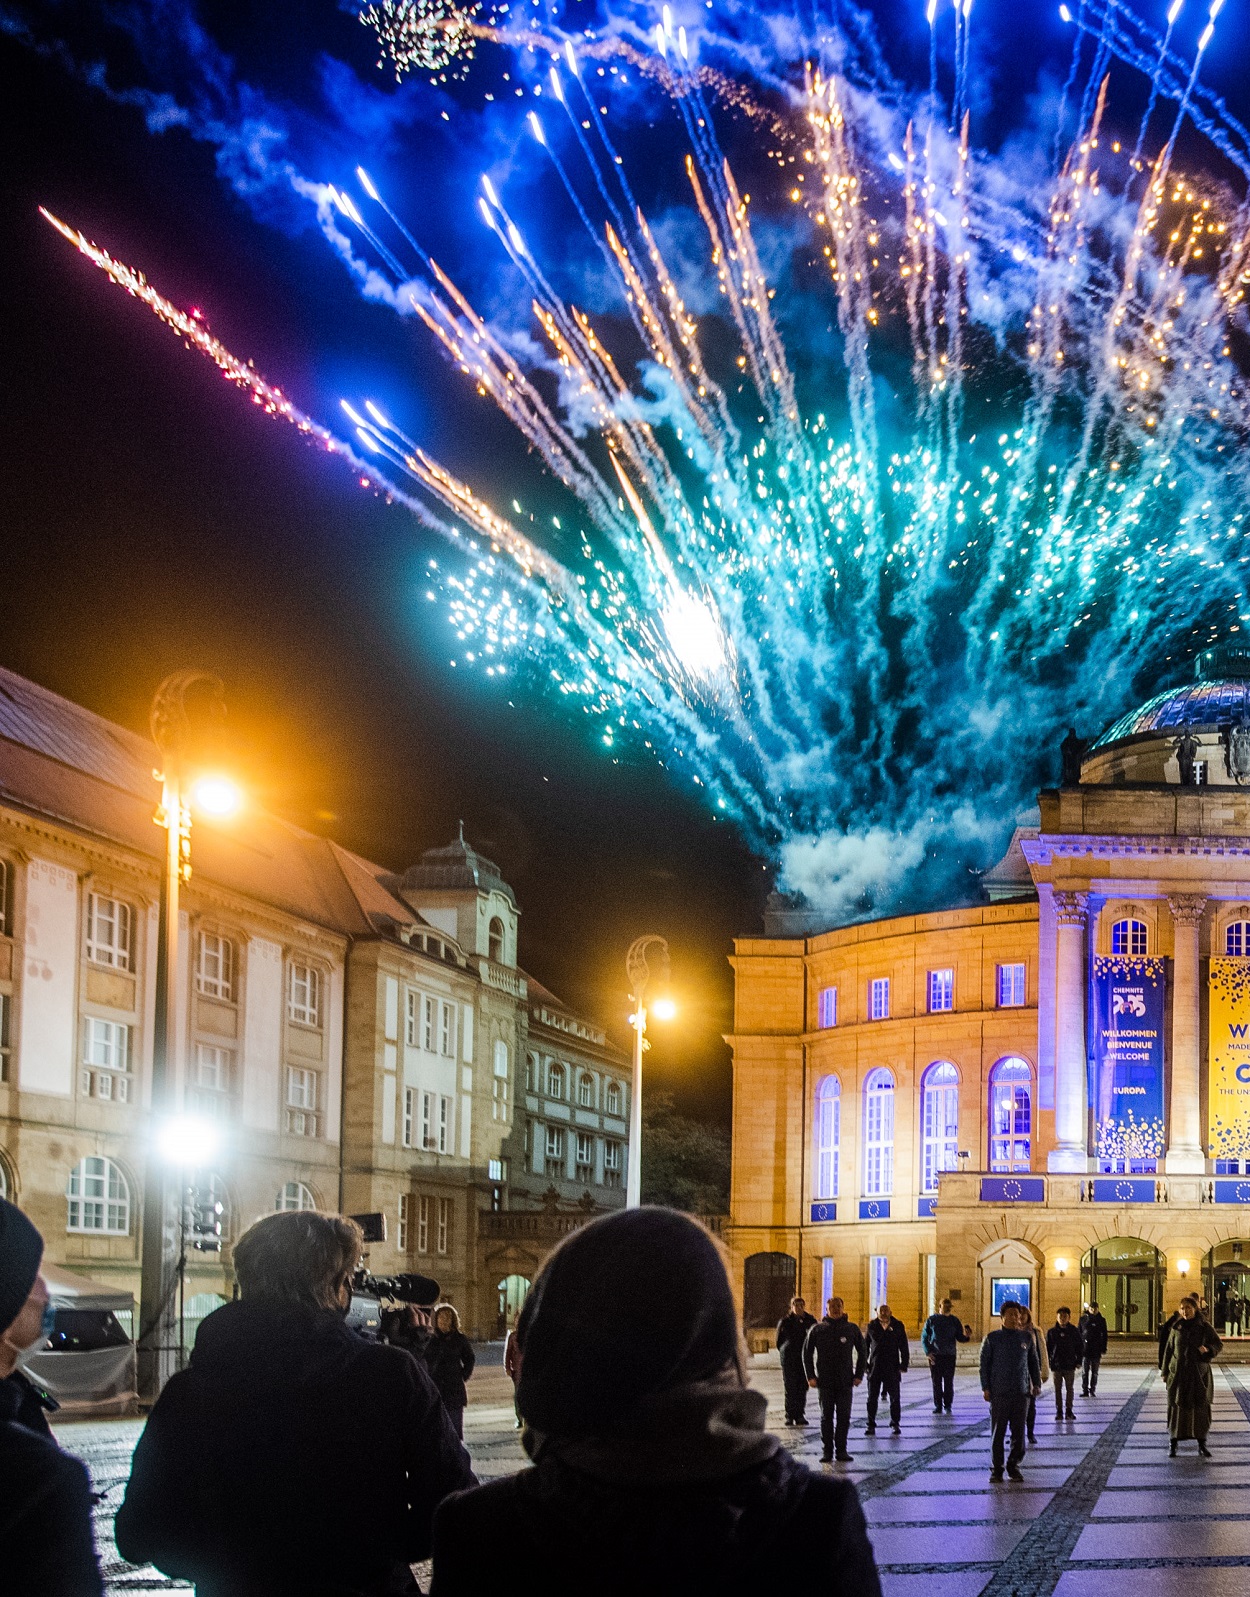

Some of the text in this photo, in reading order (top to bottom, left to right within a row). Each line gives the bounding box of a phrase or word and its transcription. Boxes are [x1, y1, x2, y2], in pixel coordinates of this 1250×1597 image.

[1102, 1030, 1157, 1038] WILLKOMMEN
[1107, 1041, 1153, 1049] BIENVENUE
[1109, 1052, 1150, 1061] WELCOME
[1113, 1087, 1146, 1095] EUROPA
[1219, 1088, 1235, 1096] THE
